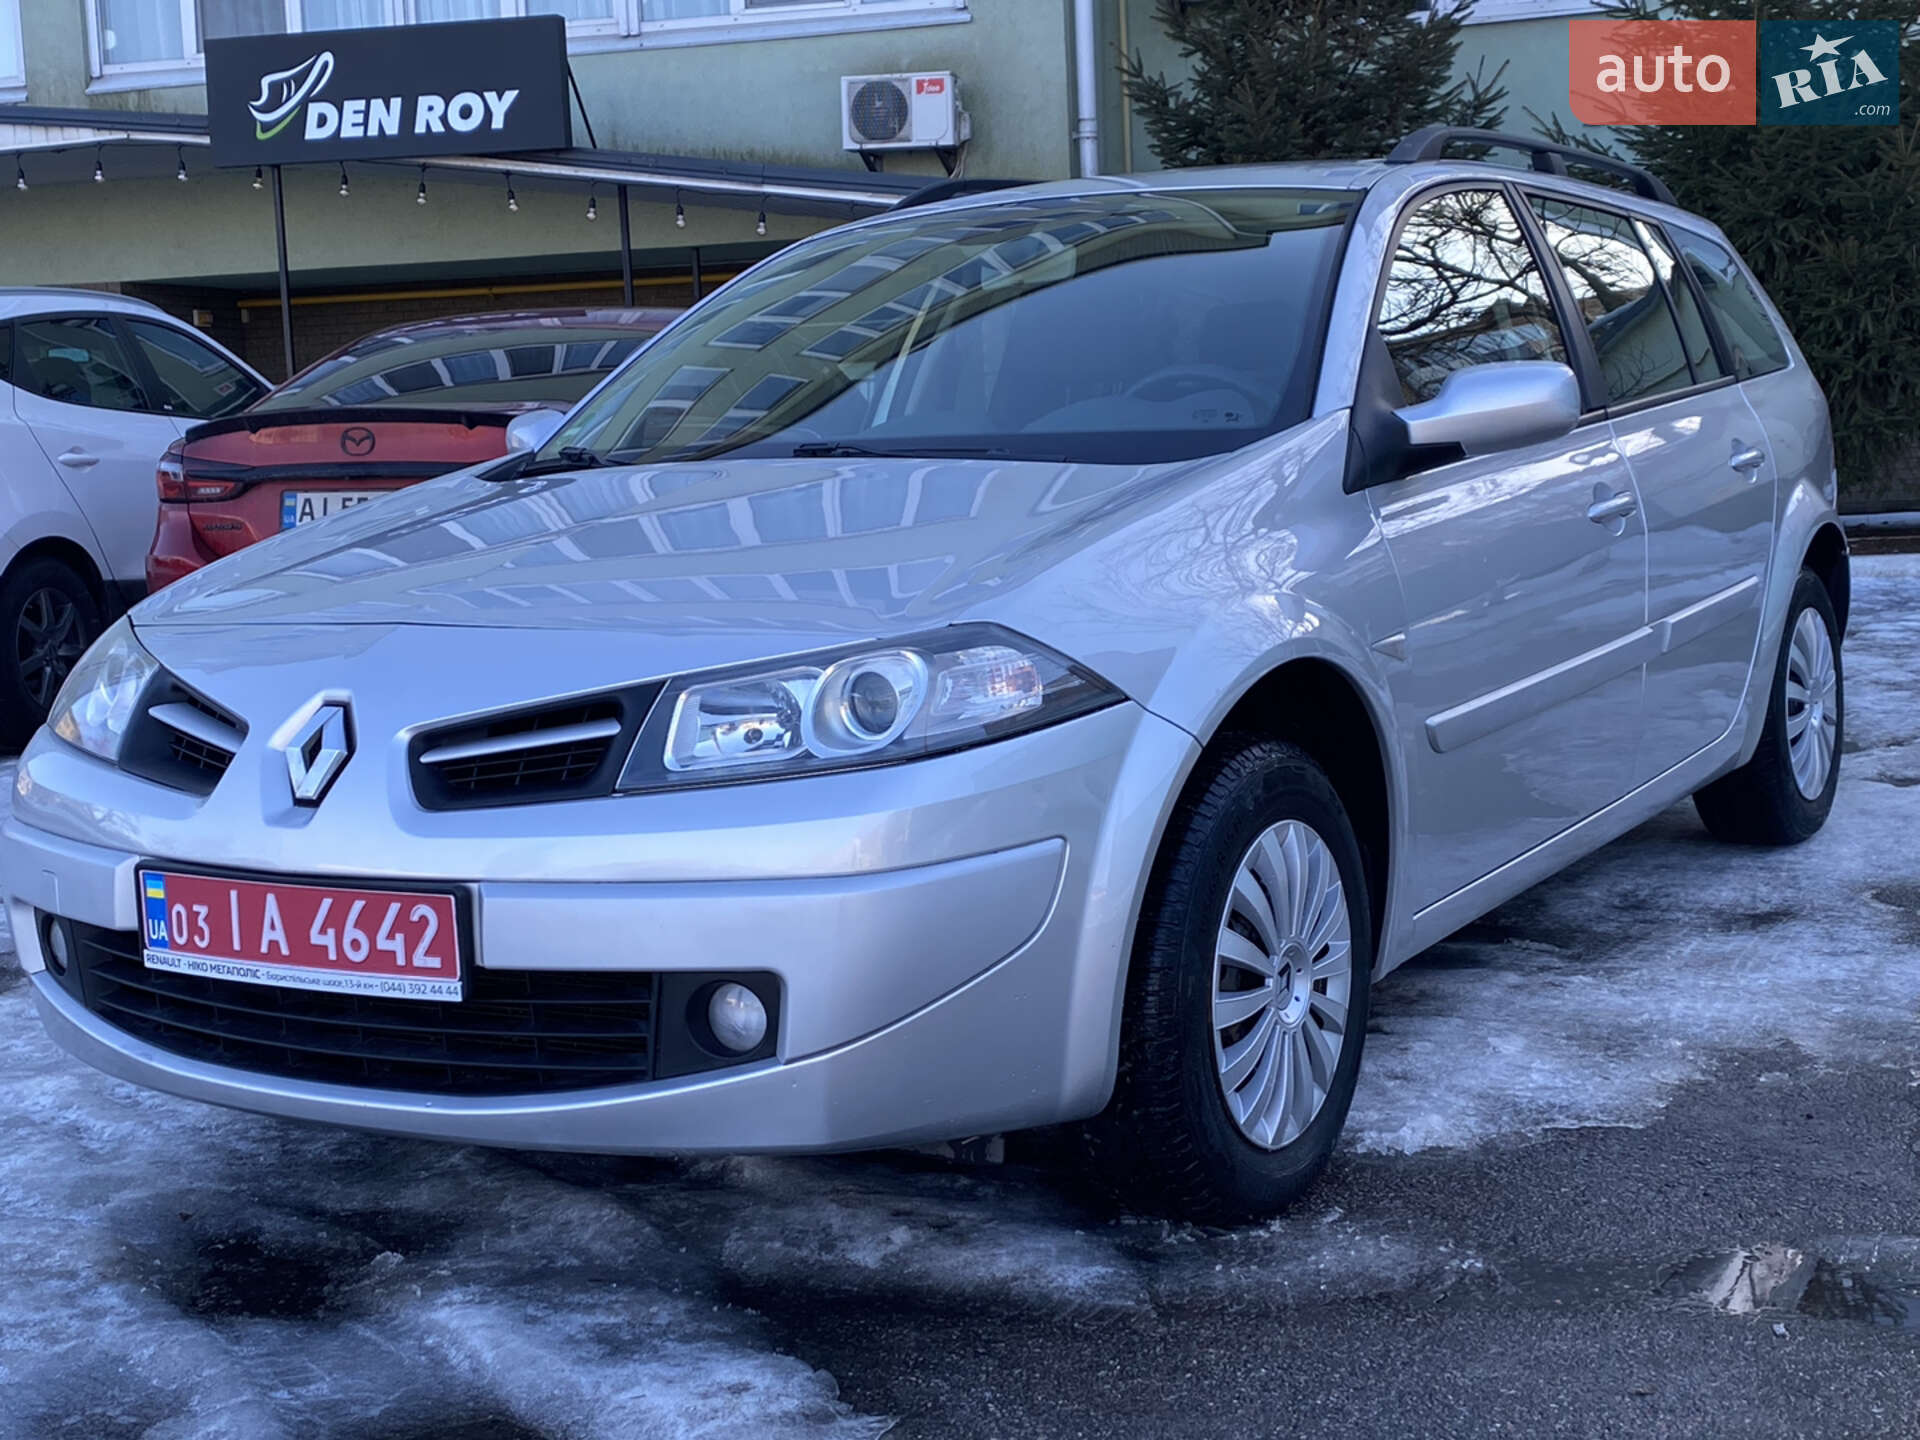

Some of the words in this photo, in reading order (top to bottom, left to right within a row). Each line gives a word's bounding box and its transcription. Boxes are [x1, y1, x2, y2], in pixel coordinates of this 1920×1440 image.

[304, 97, 402, 140] DEN
[414, 90, 519, 134] ROY
[148, 918, 168, 941] UA
[171, 903, 211, 949] 03
[310, 897, 442, 969] 4642
[146, 953, 182, 969] RENAULT
[408, 983, 428, 995] 392
[430, 984, 444, 995] 44
[446, 985, 459, 996] 44
